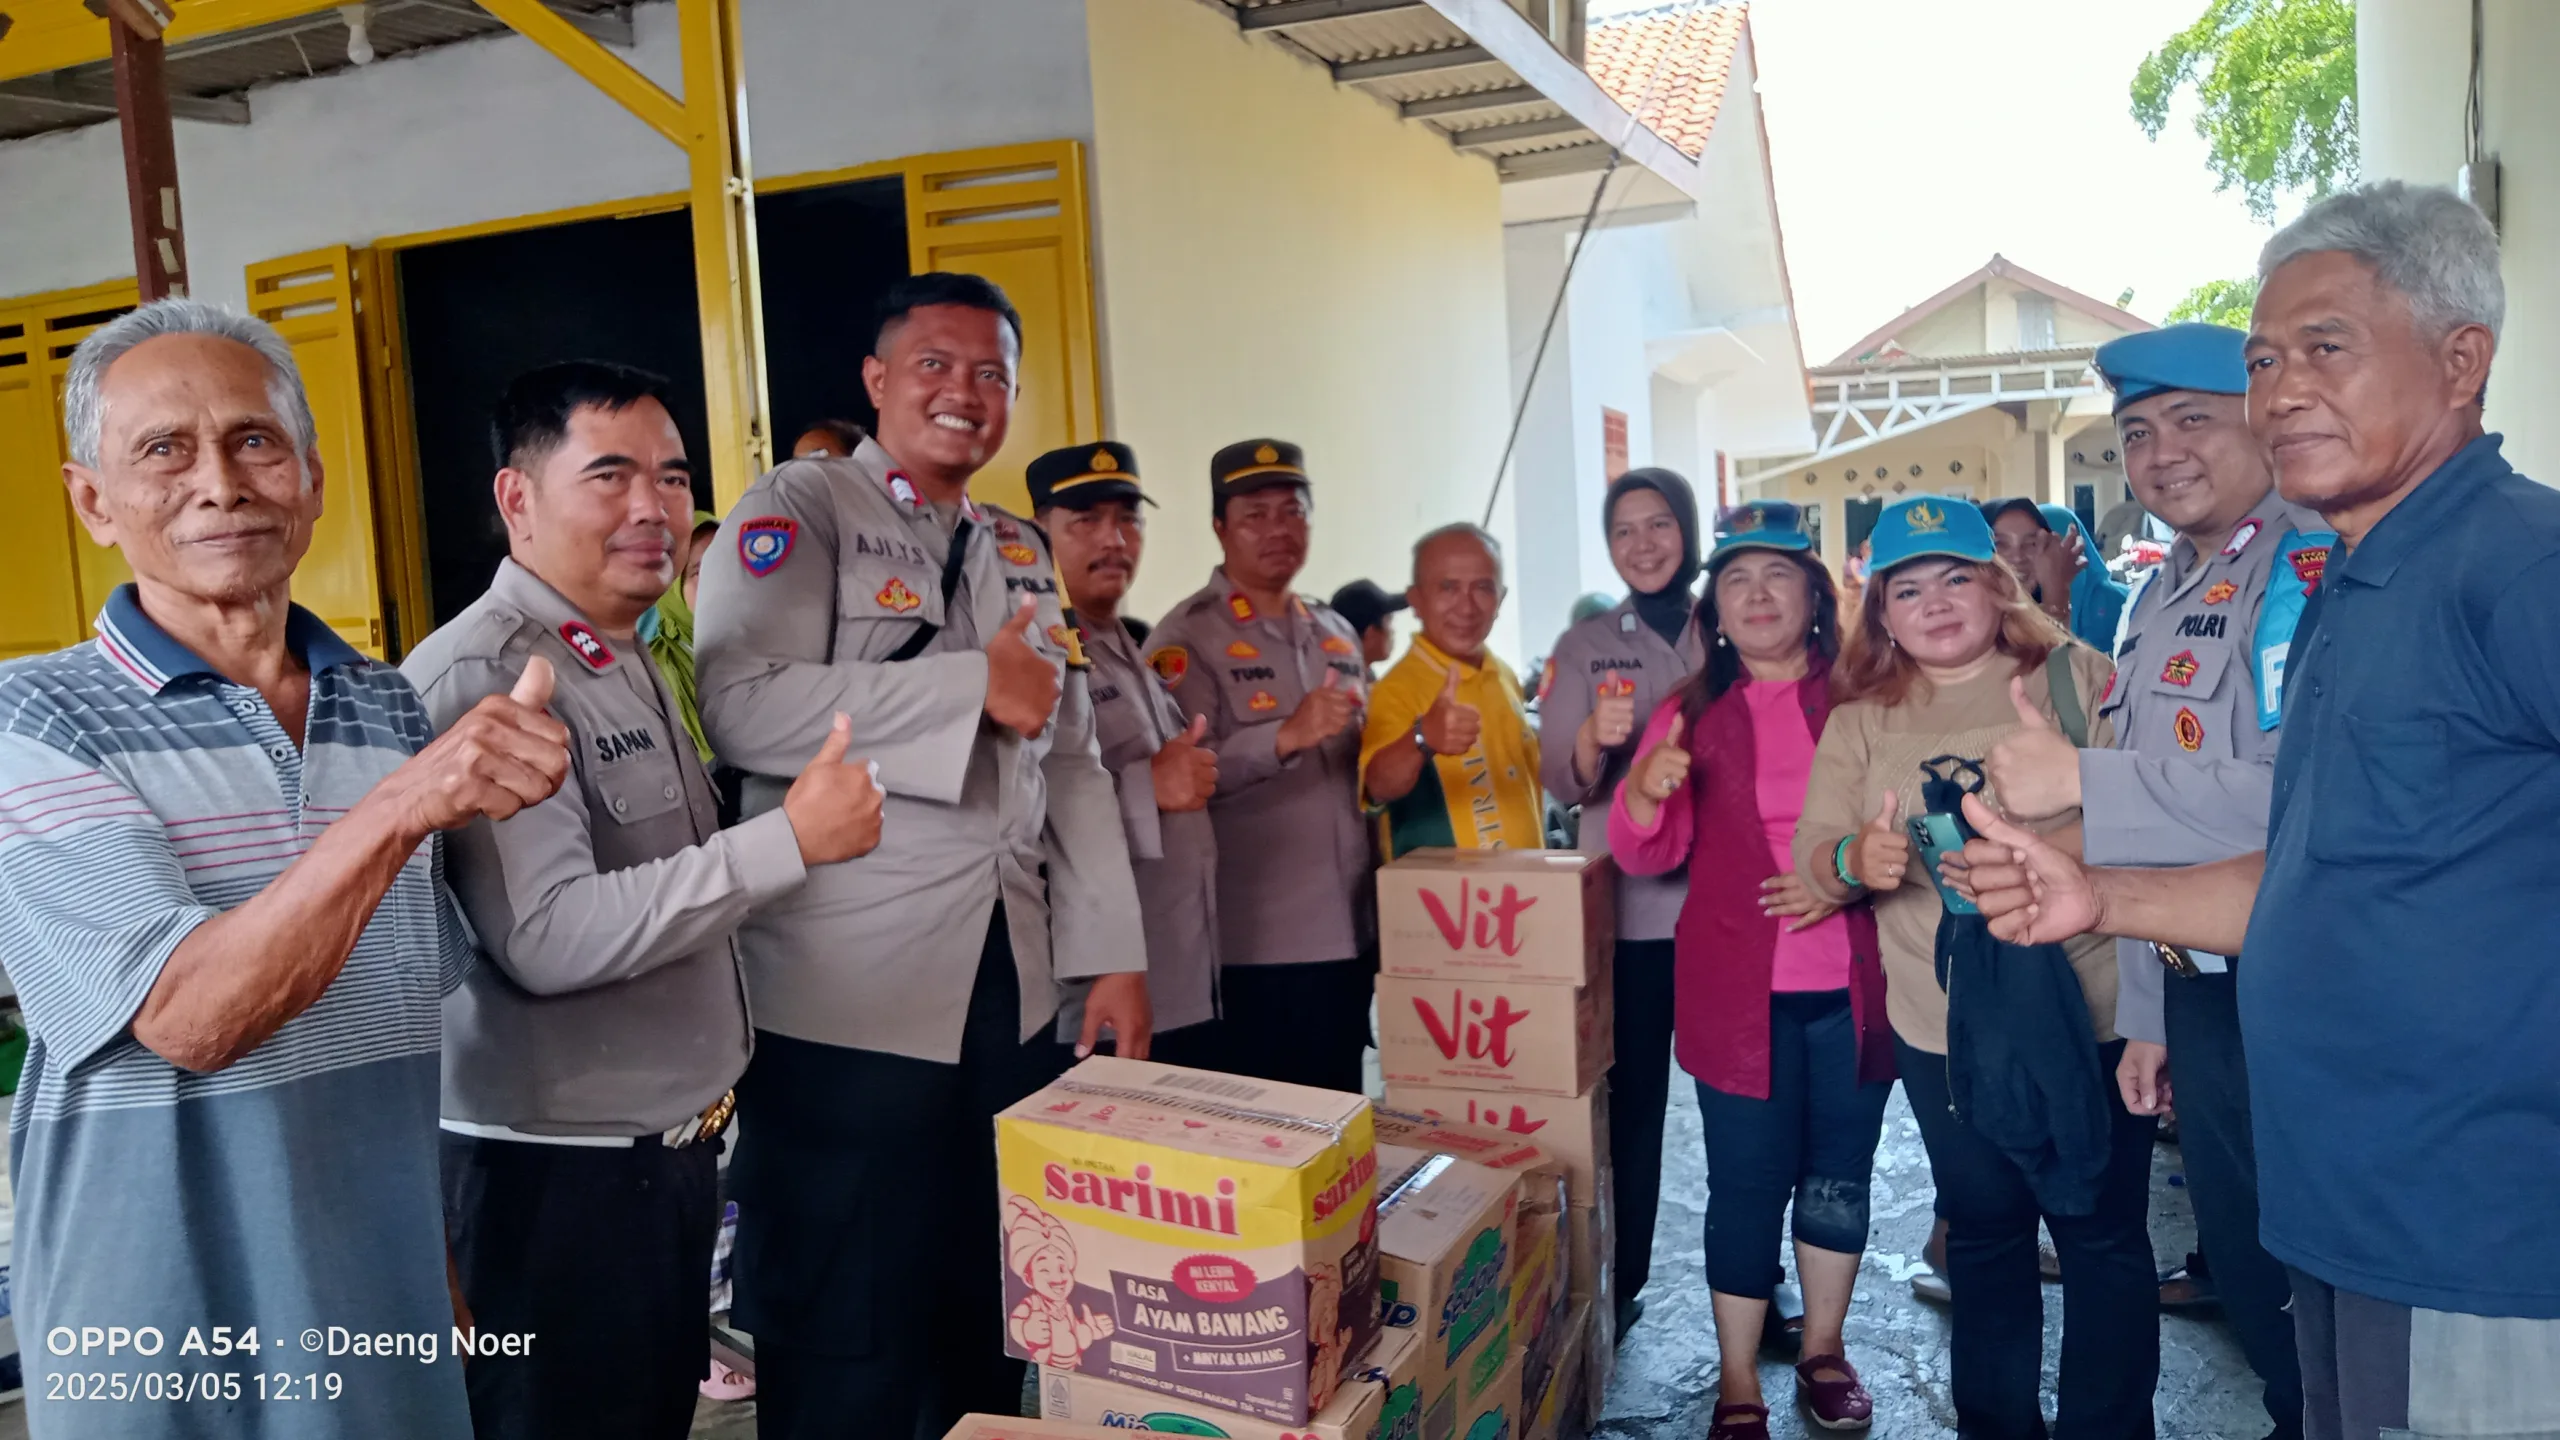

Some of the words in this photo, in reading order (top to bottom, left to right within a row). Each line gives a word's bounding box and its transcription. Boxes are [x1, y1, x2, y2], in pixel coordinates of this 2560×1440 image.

[2175, 613, 2228, 640] POLRI
[1591, 658, 1643, 674] DIANA
[1417, 877, 1538, 956] Vit
[1412, 988, 1531, 1068] Vit
[1044, 1163, 1240, 1235] sarimi
[1126, 1279, 1170, 1302] RASA
[1134, 1303, 1194, 1334] AYAM
[1196, 1306, 1289, 1337] BAWANG
[1238, 1347, 1286, 1366] BAWANG
